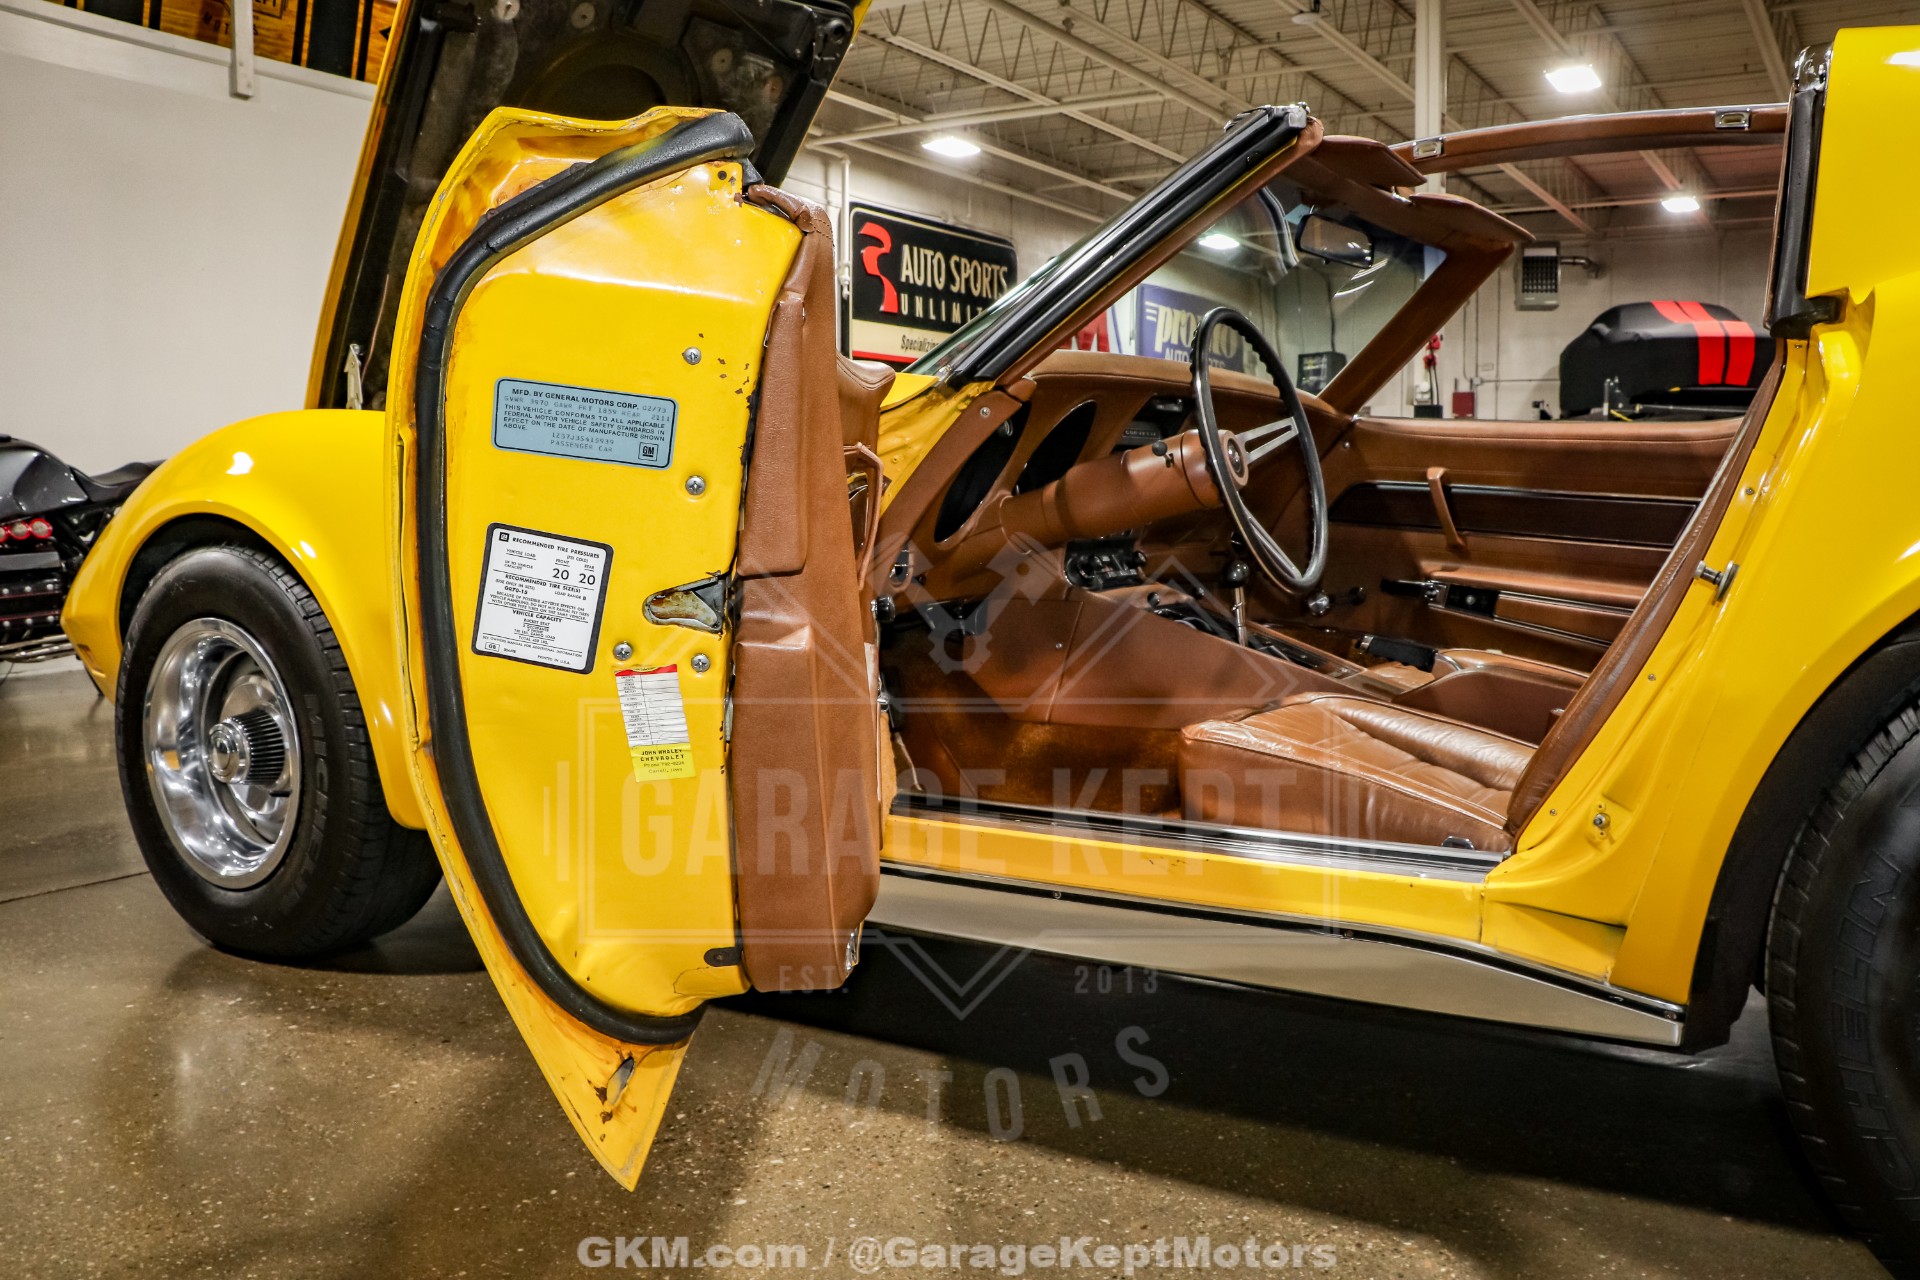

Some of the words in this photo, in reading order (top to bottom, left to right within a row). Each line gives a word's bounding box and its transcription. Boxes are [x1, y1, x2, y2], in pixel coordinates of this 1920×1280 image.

[901, 243, 946, 291] AUTO
[949, 254, 1008, 301] SPORTS
[511, 388, 532, 396] MFD.
[545, 392, 580, 402] GENERAL
[581, 397, 614, 407] MOTORS
[616, 401, 639, 410] CORP.
[504, 403, 521, 411] THIS
[523, 405, 553, 415] VEHICLE
[555, 410, 596, 420] CONFORMS
[627, 419, 665, 429] APPLICABLE
[504, 410, 533, 419] FEDERAL
[535, 414, 558, 422] MOTOR
[560, 417, 588, 426] VEHICLE
[590, 421, 615, 429] SAFETY
[616, 424, 655, 435] STANDARDS
[503, 416, 529, 424] EFFECT
[558, 423, 575, 431] DATE
[588, 427, 639, 439] MANUFACTURE
[640, 432, 665, 442] SHOWN
[642, 445, 655, 455] GM
[512, 537, 555, 550] RECOMMENDED
[557, 545, 568, 553] TIRE
[570, 549, 600, 559] PRESSURES
[505, 573, 547, 586] RECOMMENDED
[549, 582, 561, 590] TIRE
[552, 567, 570, 580] 20
[579, 573, 596, 586] 20
[504, 585, 528, 595] GR70-15
[512, 609, 534, 618] VEHICLE
[535, 613, 563, 623] CAPACITY
[640, 754, 684, 762] CHEVROLET
